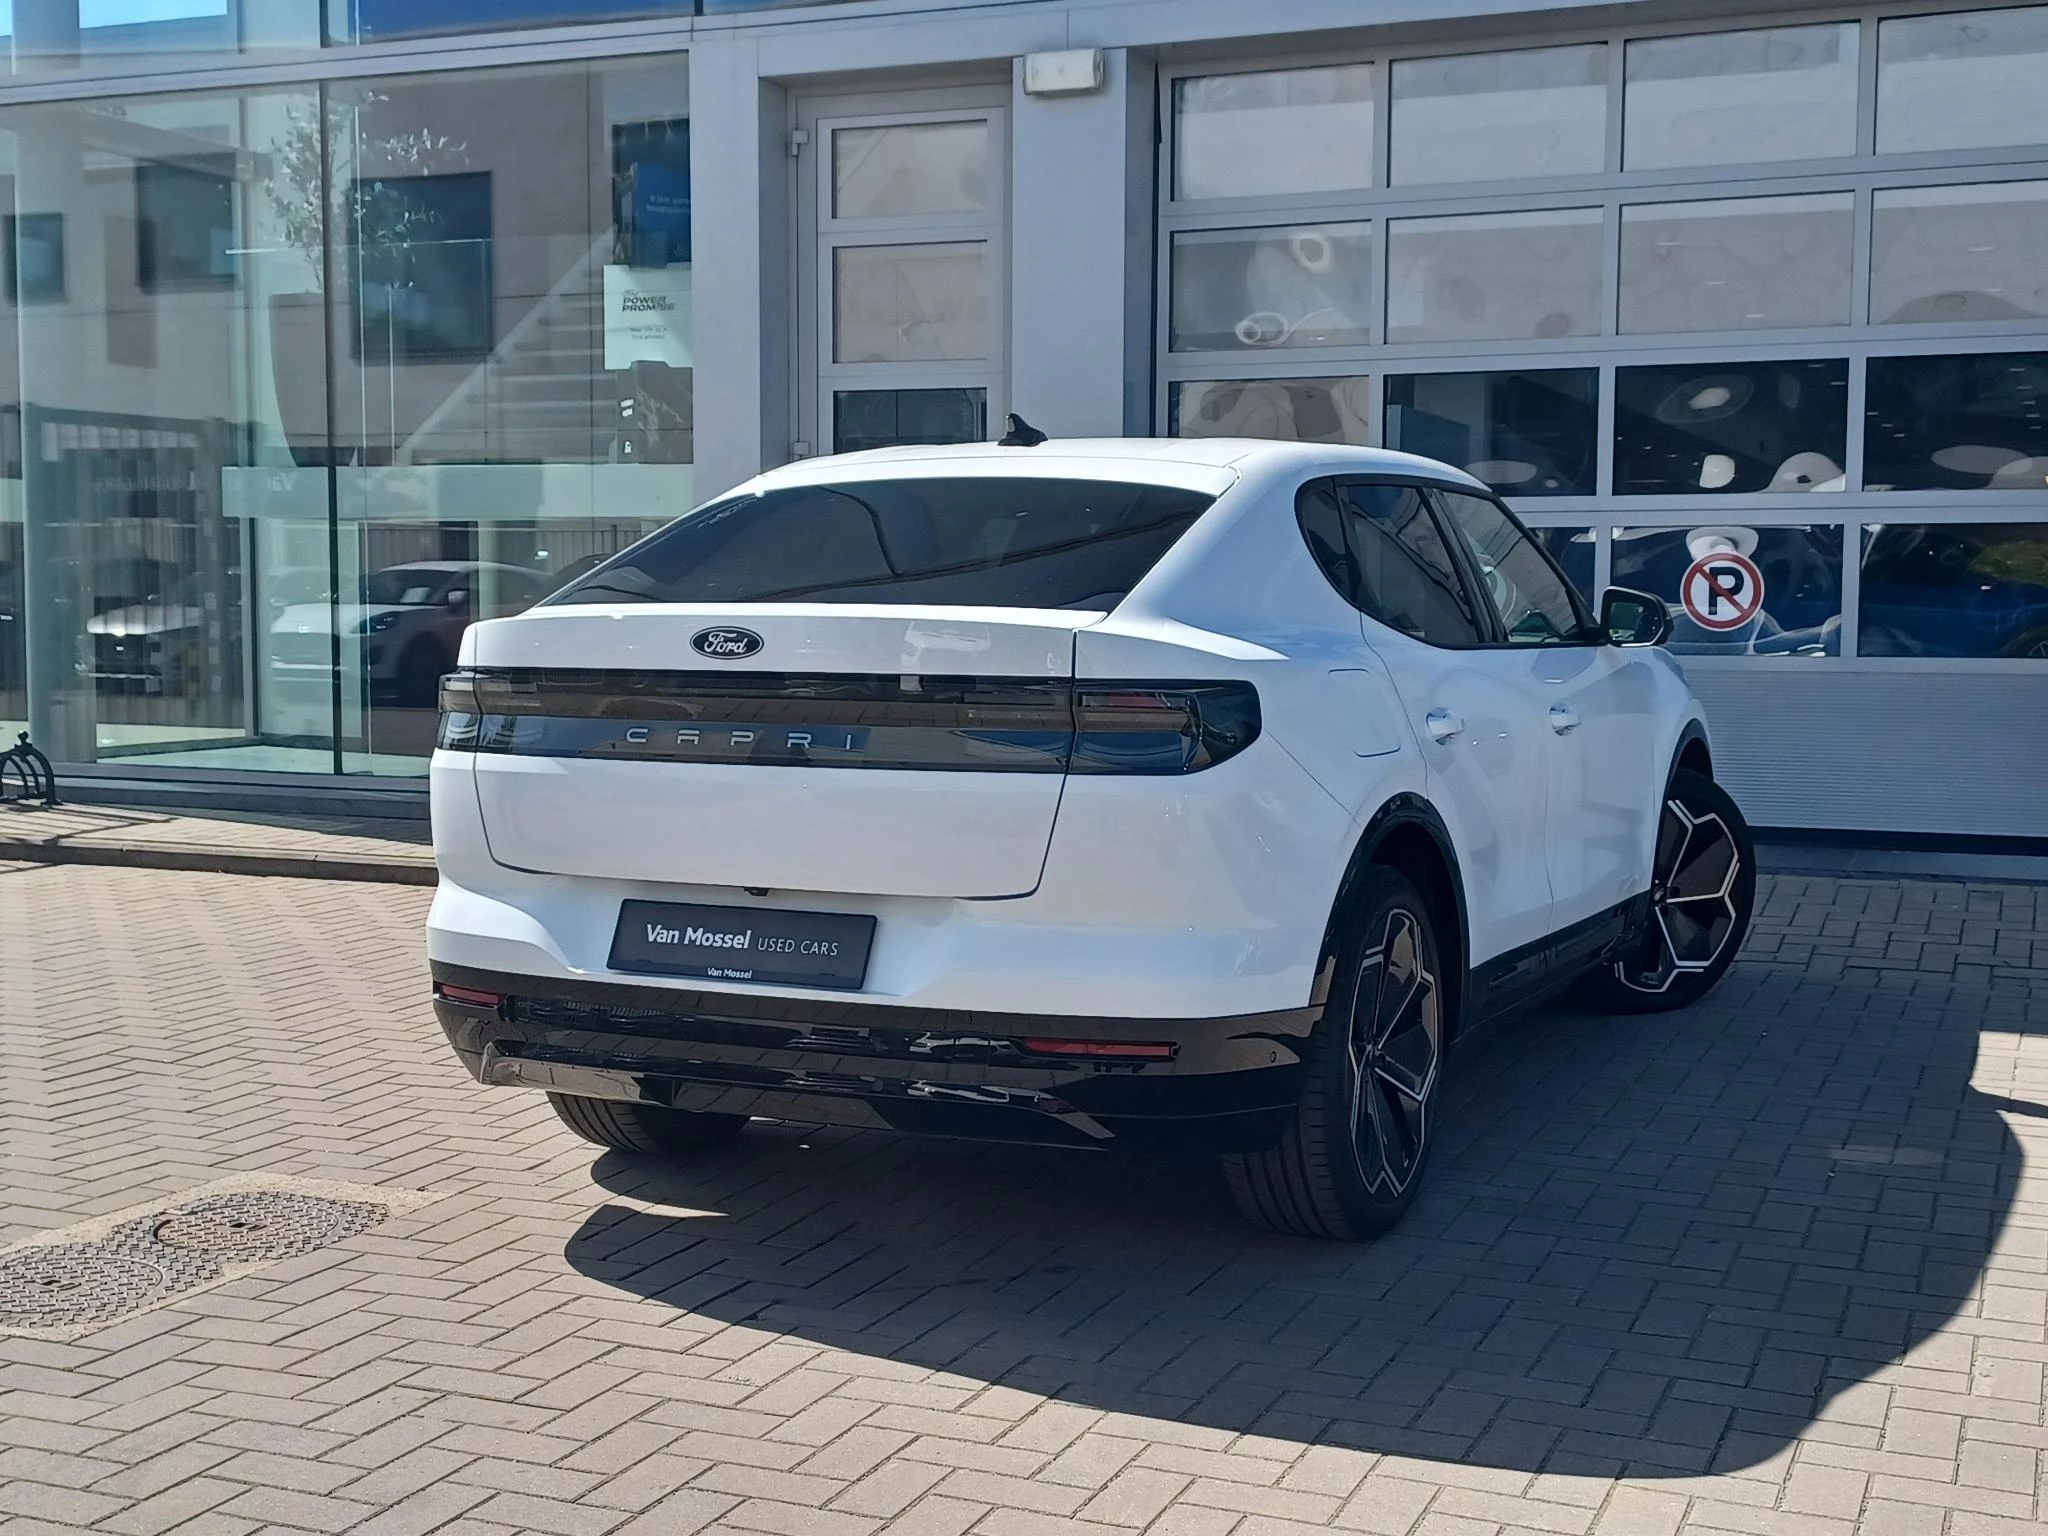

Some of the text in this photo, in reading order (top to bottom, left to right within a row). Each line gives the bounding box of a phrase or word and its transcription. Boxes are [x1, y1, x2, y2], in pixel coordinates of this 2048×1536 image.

[623, 295, 667, 305] POWER
[1708, 566, 1745, 616] P
[703, 631, 748, 654] Ford
[626, 727, 853, 751] CAPRI
[646, 923, 839, 956] Van Mossel USED CARS
[707, 967, 753, 979] Van Mossel
